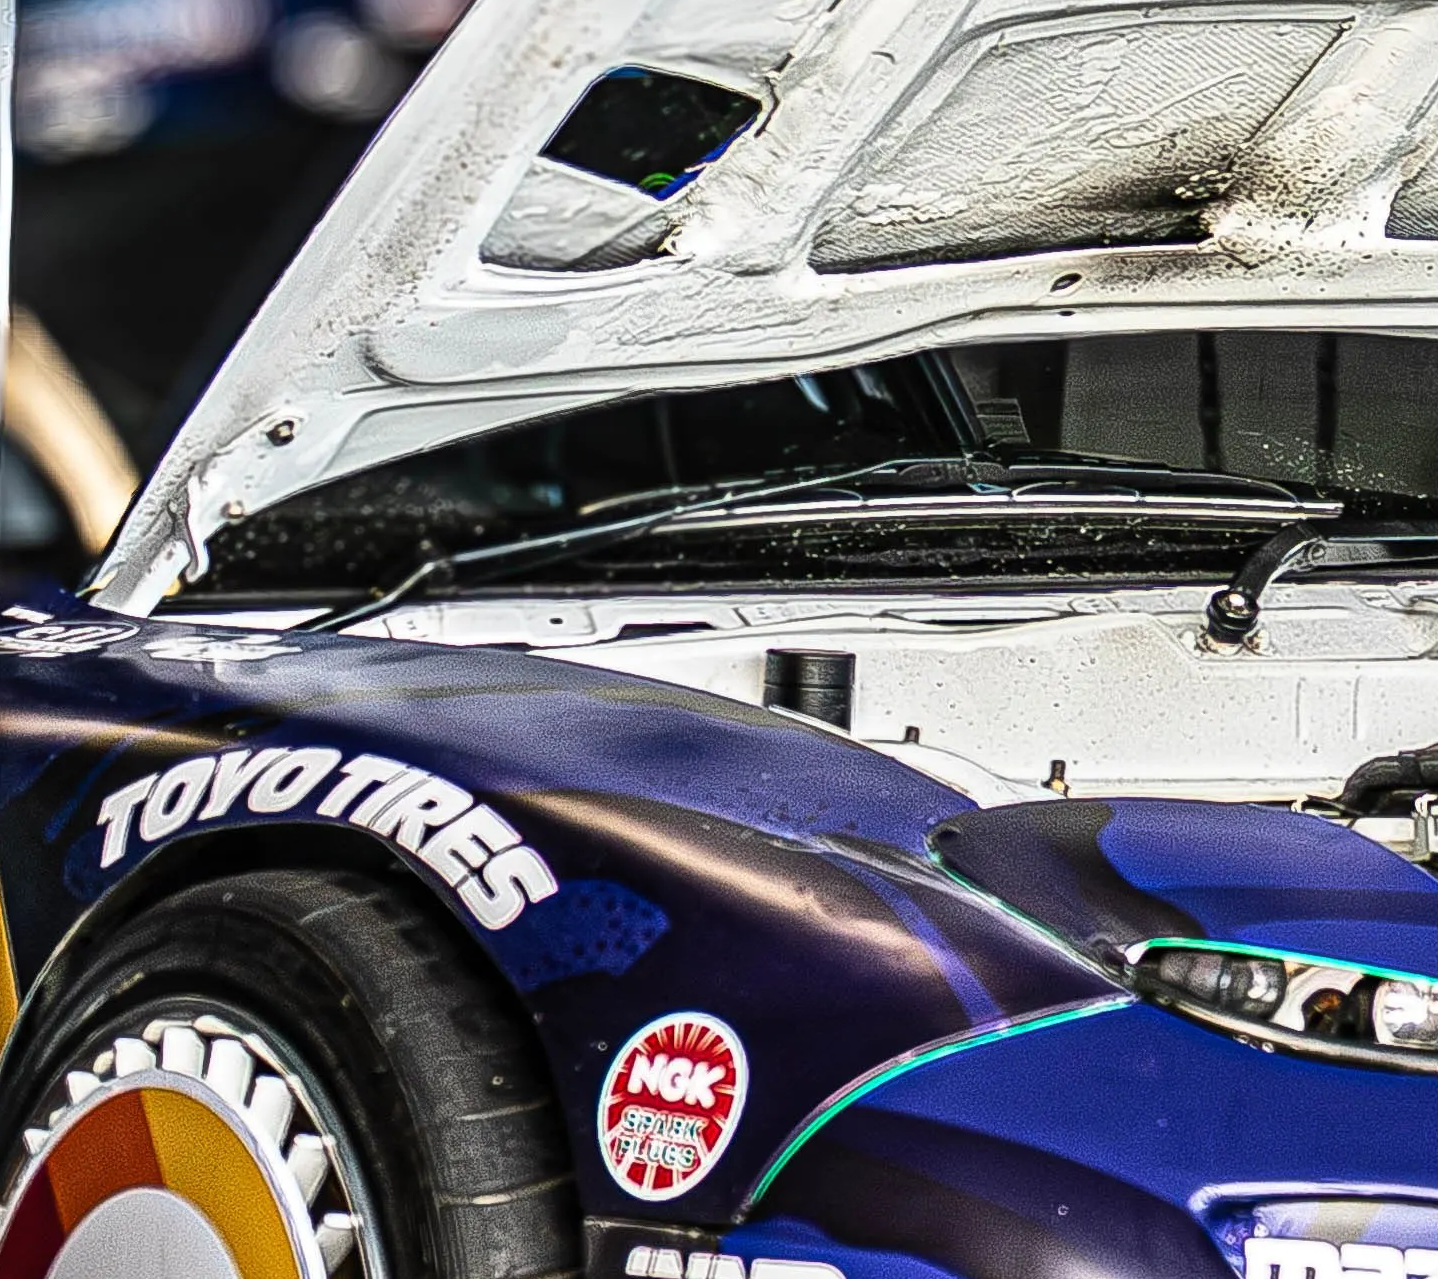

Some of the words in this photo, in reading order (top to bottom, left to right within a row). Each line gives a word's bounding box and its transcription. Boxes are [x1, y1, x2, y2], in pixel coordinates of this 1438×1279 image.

[95, 747, 343, 869] TOYO
[316, 752, 559, 931] TIRES
[627, 1053, 727, 1109] NGK
[621, 1105, 707, 1143] SPARK
[614, 1135, 700, 1169] PLUGS
